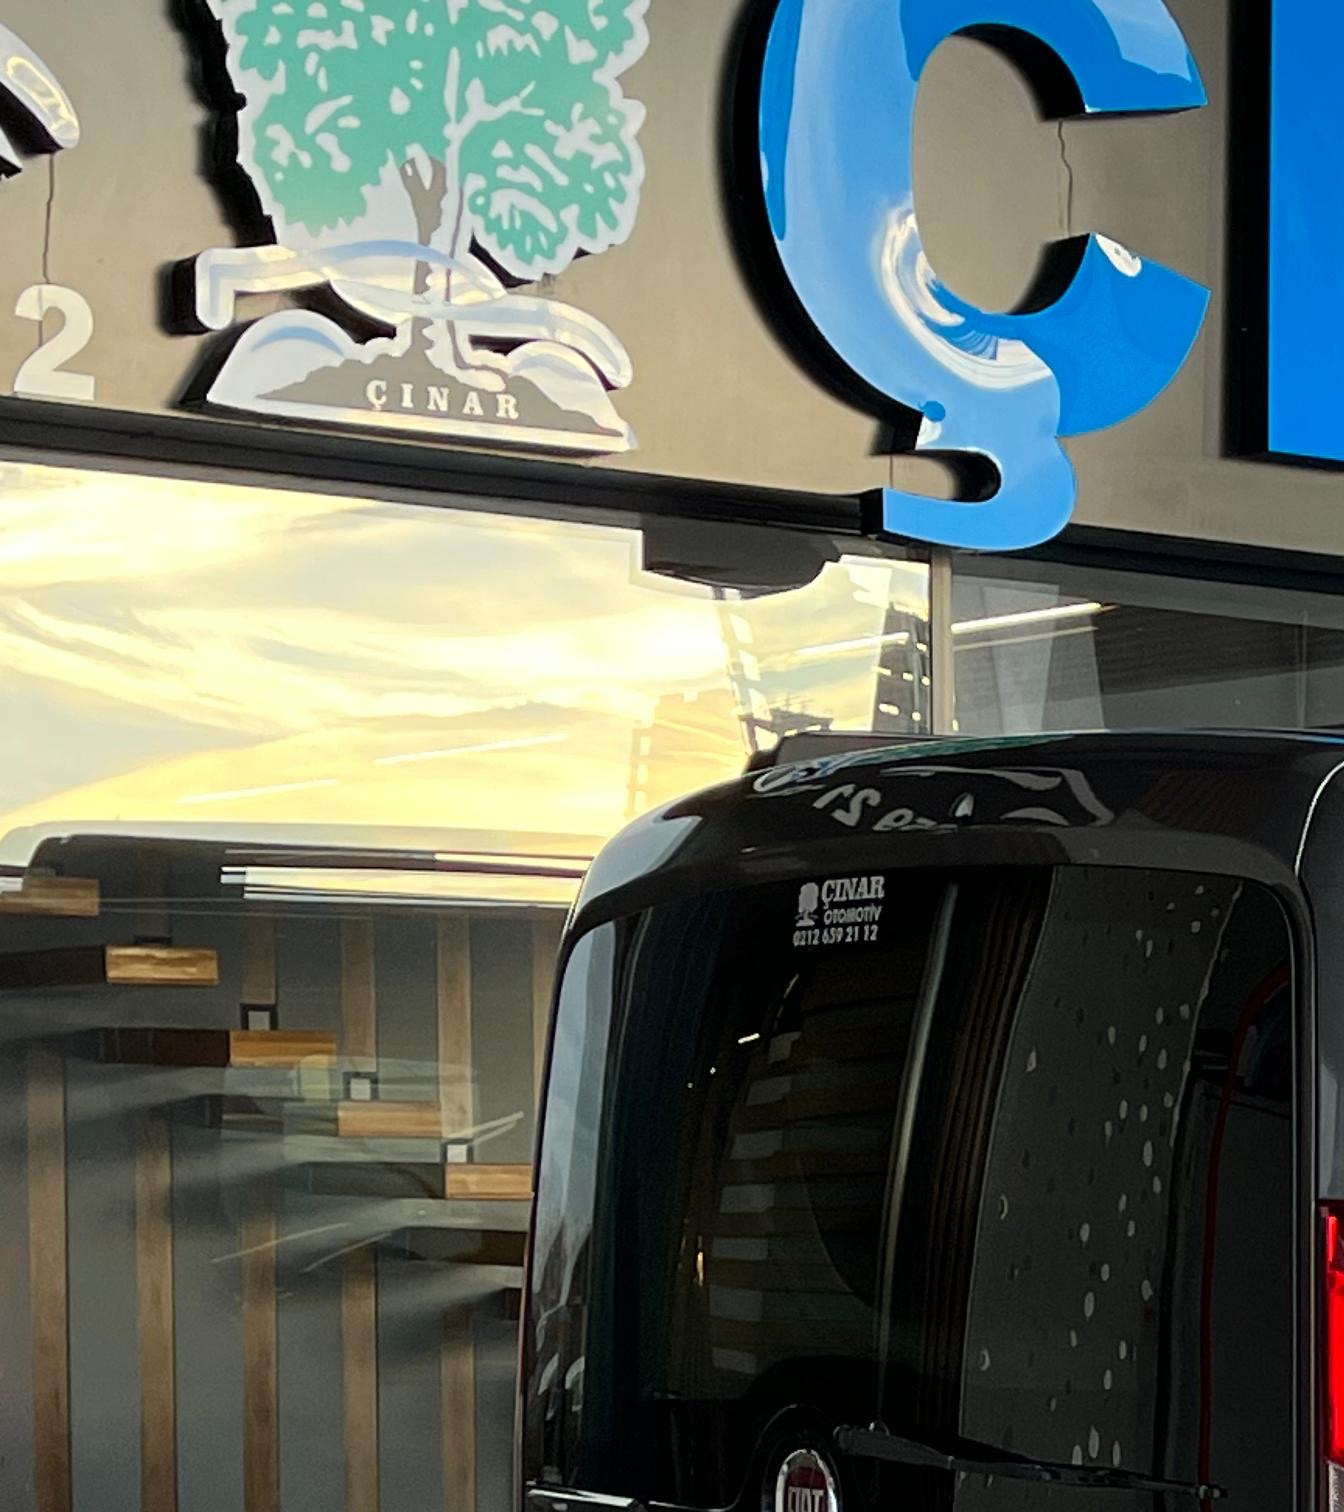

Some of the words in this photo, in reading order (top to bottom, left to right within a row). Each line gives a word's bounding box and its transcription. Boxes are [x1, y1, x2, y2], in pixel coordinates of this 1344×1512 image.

[13, 283, 95, 400] 2
[365, 378, 520, 420] ÇINAR
[821, 876, 885, 909] ÇINAR
[823, 902, 883, 925] OTOMOTİV
[845, 926, 860, 942] 21
[863, 924, 879, 941] 12
